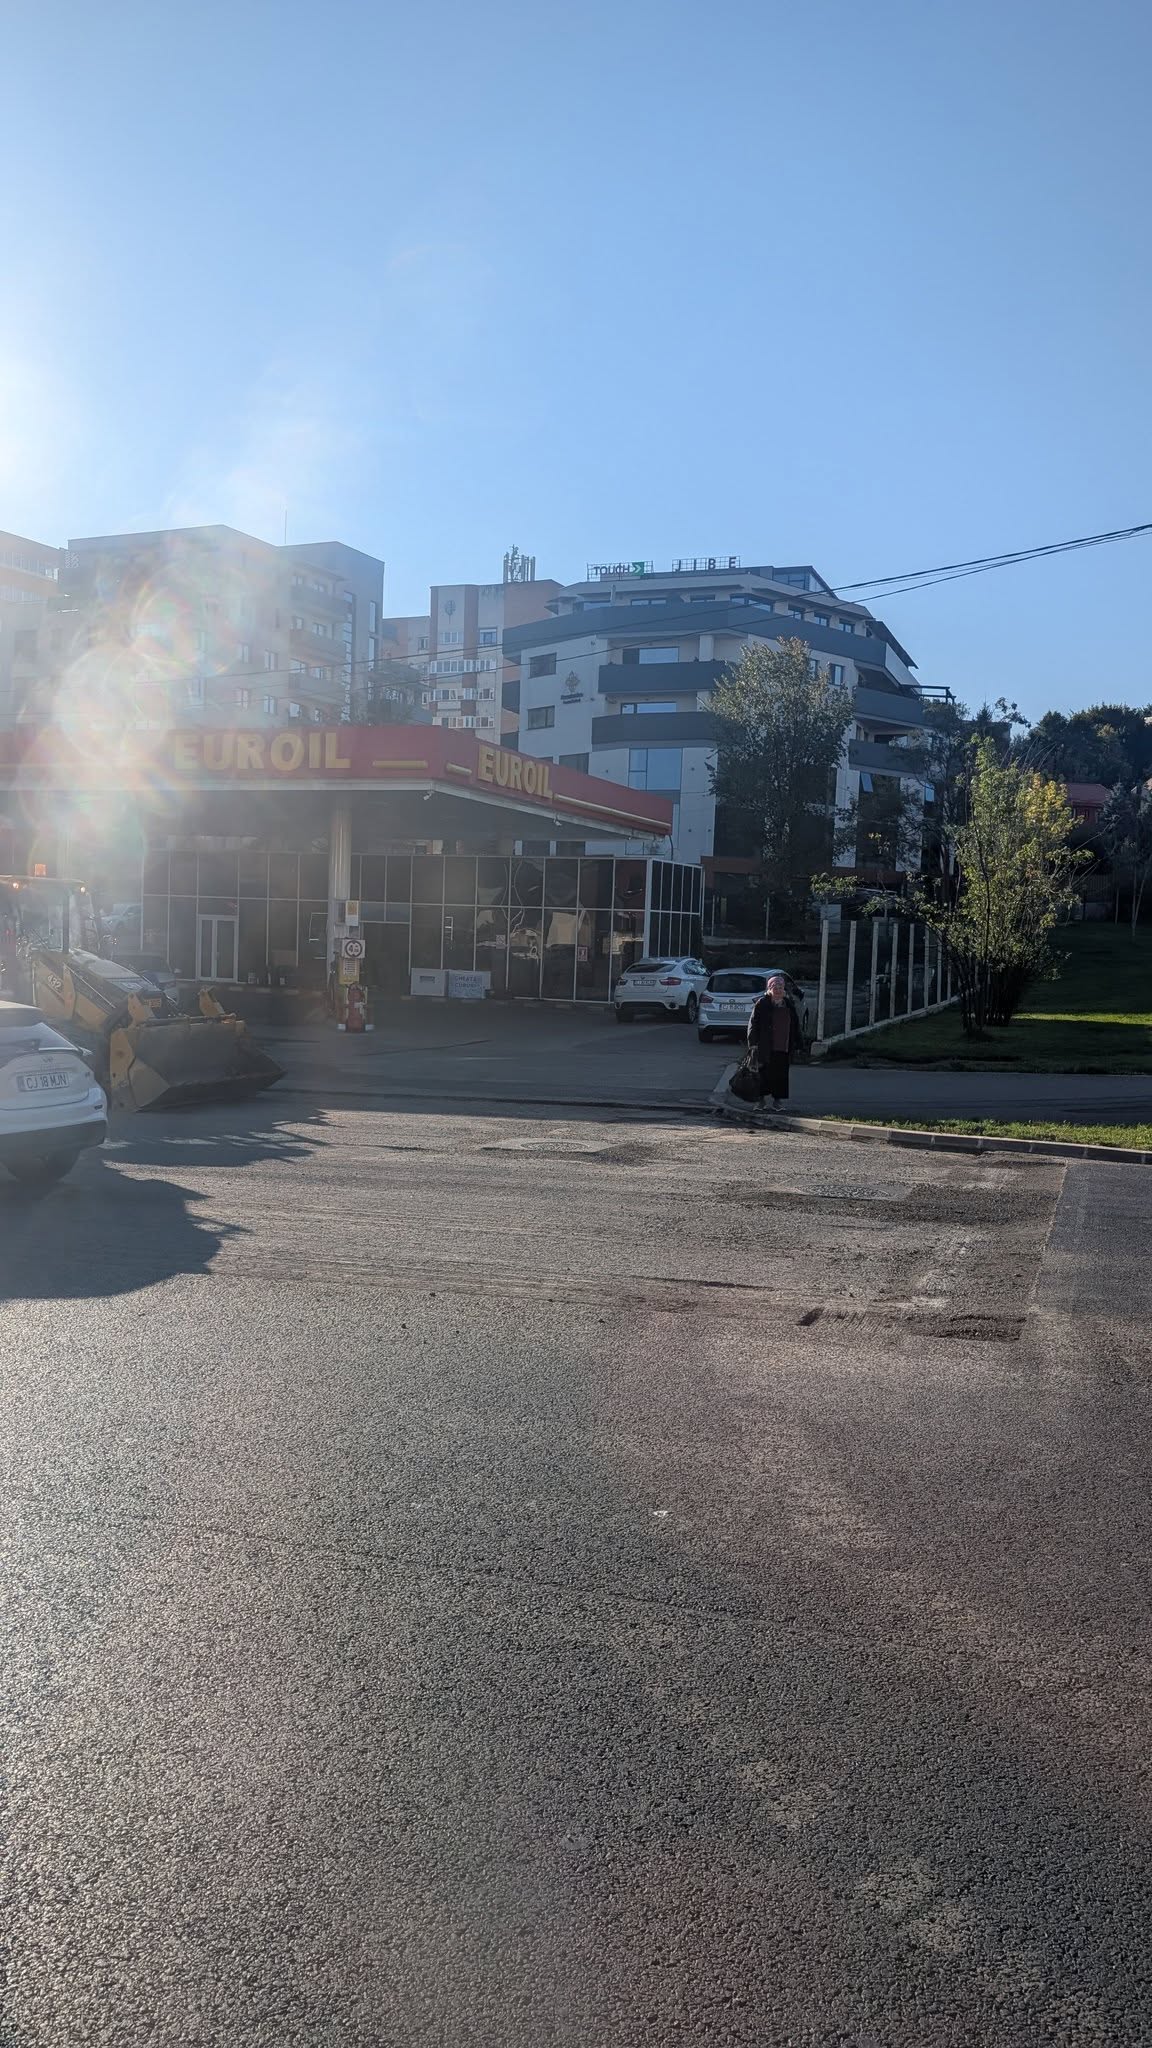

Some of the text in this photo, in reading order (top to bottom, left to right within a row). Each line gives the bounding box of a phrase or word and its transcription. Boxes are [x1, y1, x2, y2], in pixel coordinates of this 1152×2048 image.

[593, 563, 630, 576] TOUCH
[173, 731, 351, 772] EUROIL
[477, 743, 554, 800] EUROIL
[26, 1076, 38, 1090] CJ
